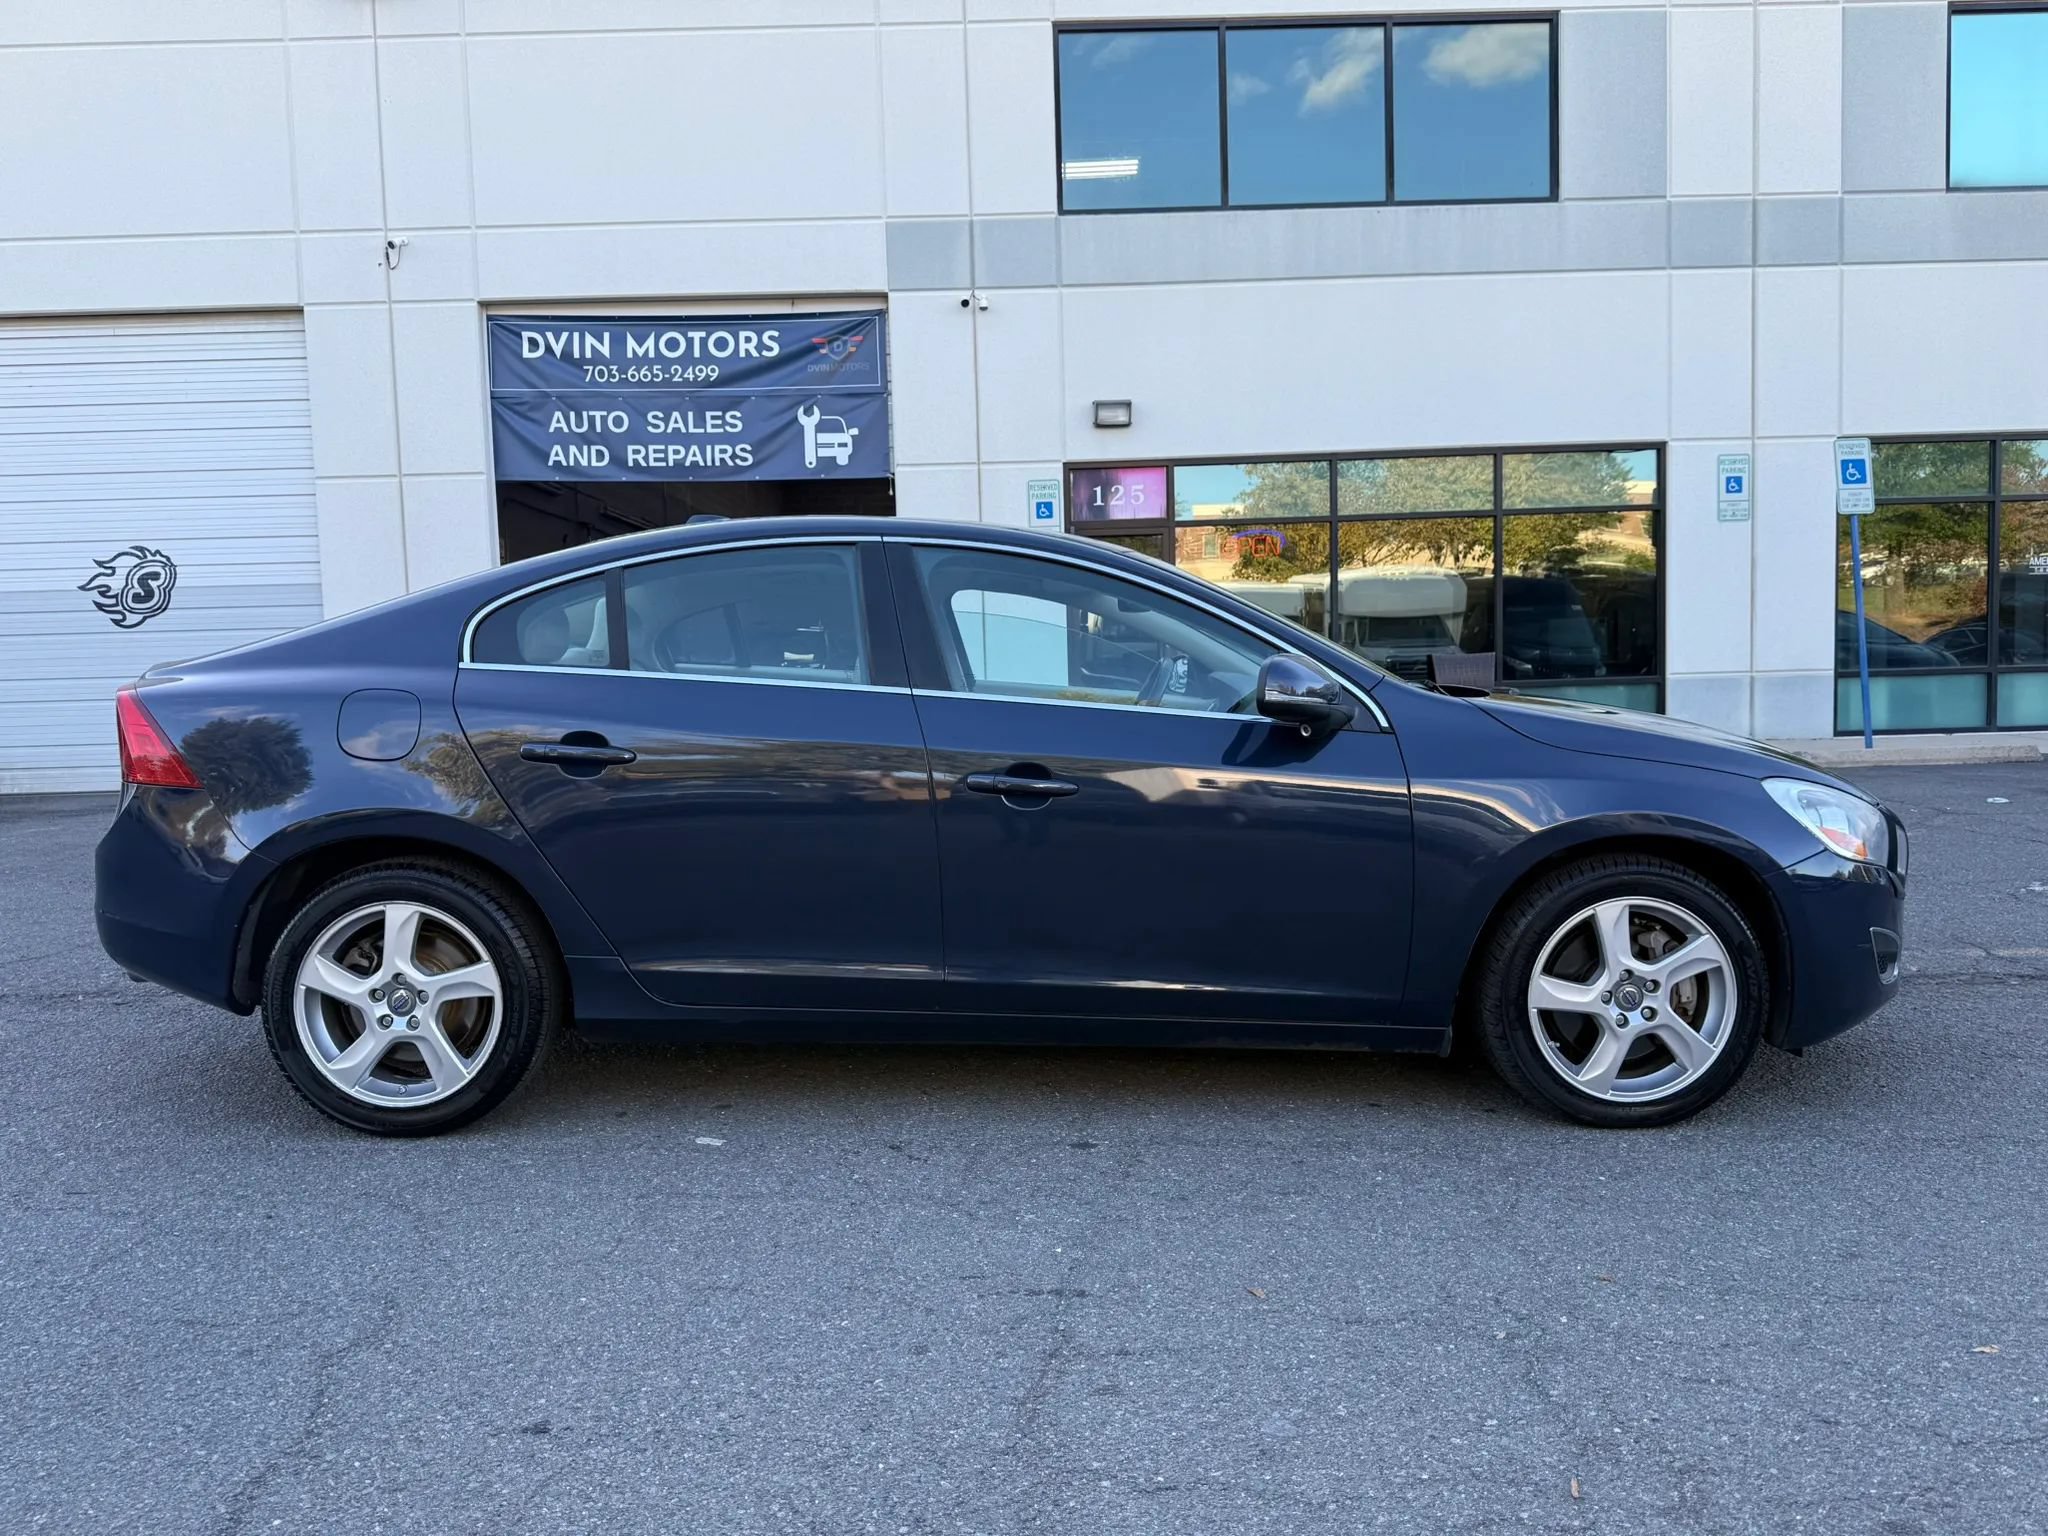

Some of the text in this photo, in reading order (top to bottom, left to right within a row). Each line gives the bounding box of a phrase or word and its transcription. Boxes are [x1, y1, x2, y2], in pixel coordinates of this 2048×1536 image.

[521, 330, 780, 359] DVIN MOTORS
[583, 365, 719, 382] 703-665-2499
[808, 363, 830, 372] DVIN
[548, 411, 743, 433] AUTO SALES
[547, 444, 754, 467] AND REPAIRS
[1093, 484, 1145, 506] 125
[1223, 536, 1281, 560] OPEN
